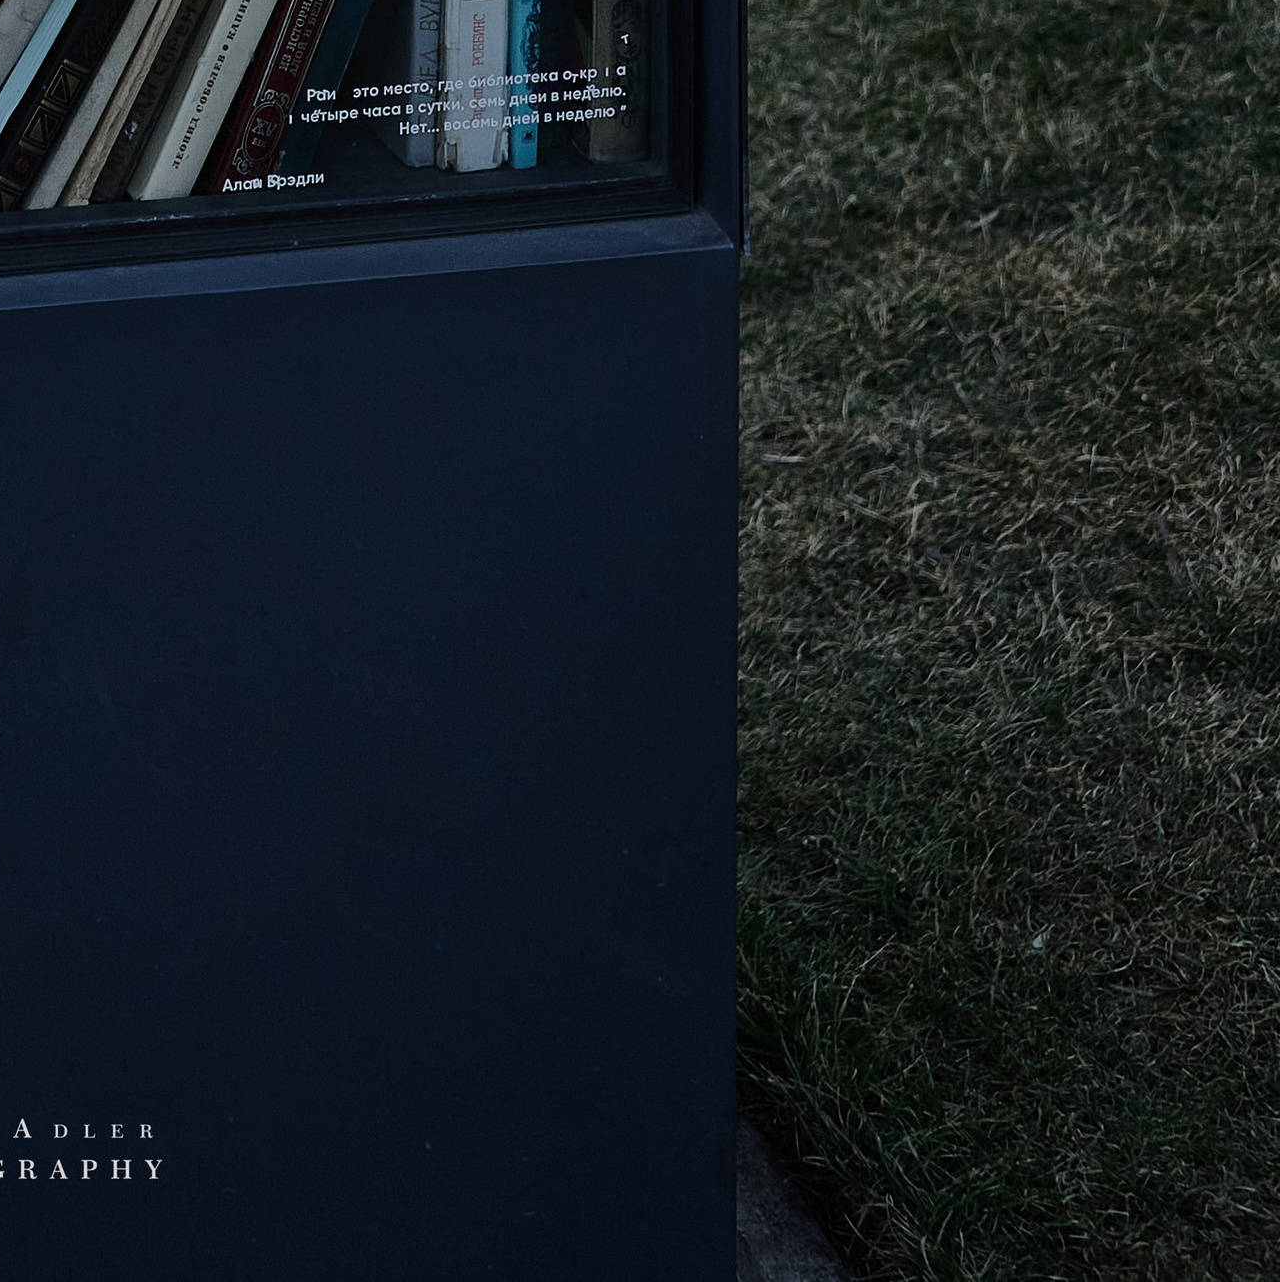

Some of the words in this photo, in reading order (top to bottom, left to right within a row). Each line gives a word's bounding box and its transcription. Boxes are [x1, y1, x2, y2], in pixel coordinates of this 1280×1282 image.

[472, 13, 486, 67] РОББИНС
[352, 85, 379, 99] это
[383, 82, 433, 97] место,
[467, 70, 559, 90] библиотека
[169, 115, 200, 170] ЛЕОНИД
[193, 52, 227, 114] СОБОЛЕВ
[362, 104, 402, 119] часа
[443, 116, 499, 132] восемь
